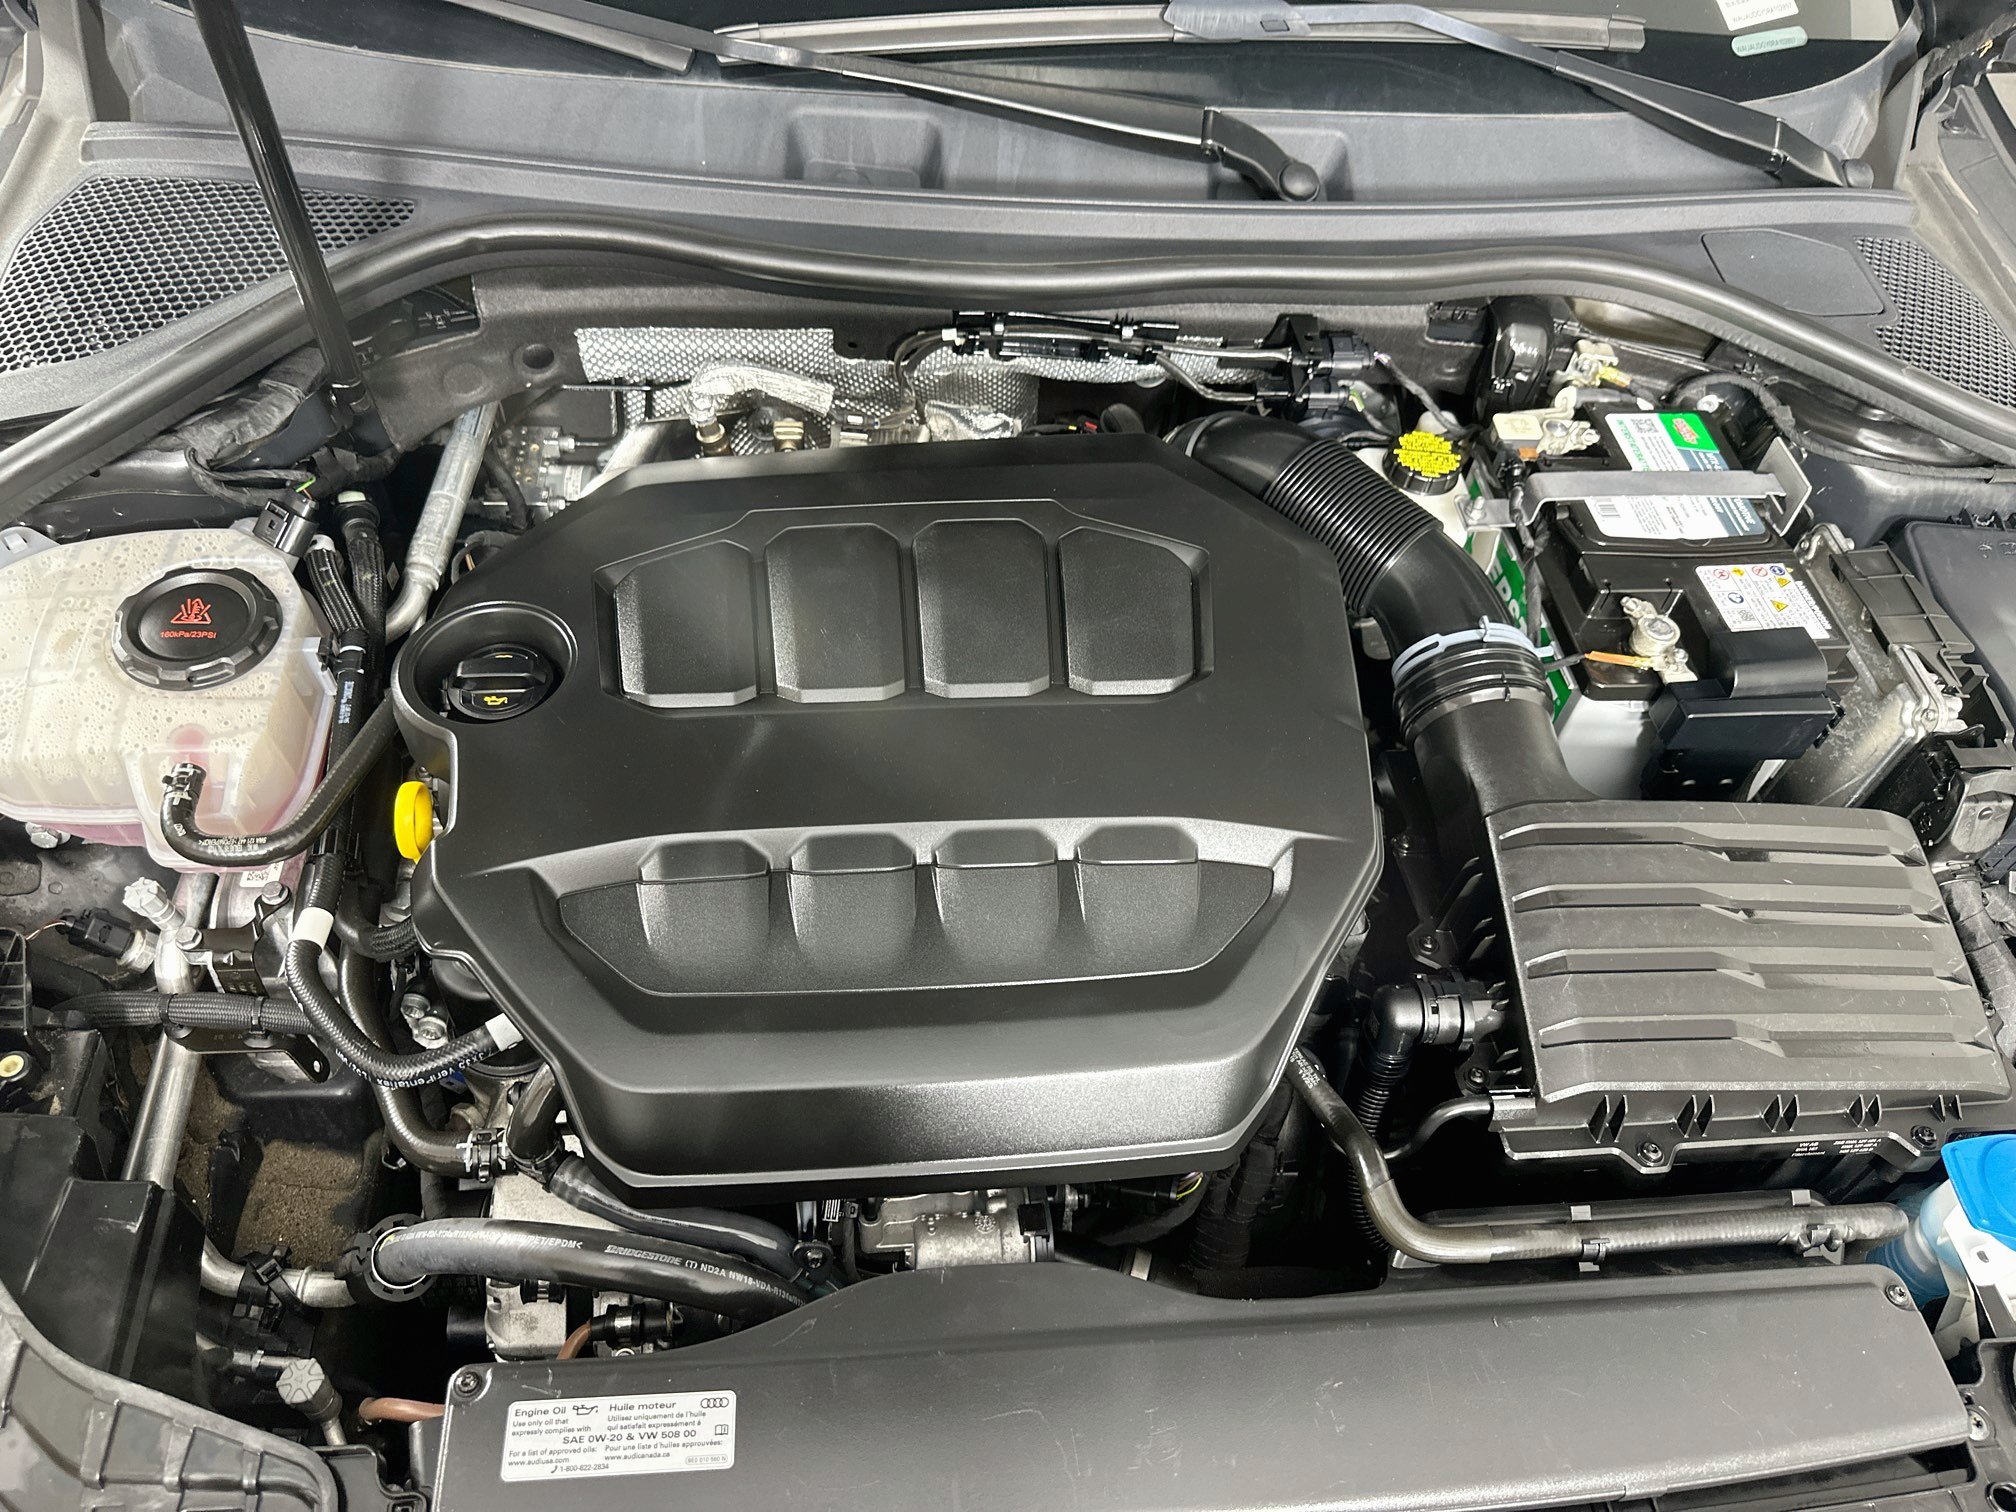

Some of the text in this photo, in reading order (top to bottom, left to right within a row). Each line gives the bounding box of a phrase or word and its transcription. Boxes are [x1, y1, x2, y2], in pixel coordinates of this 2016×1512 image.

[160, 630, 216, 639] 160kPa/23PSI
[605, 1245, 683, 1265] BRIDGESTONE
[685, 1258, 698, 1270] (T)
[700, 1262, 726, 1277] ND2A
[609, 1403, 635, 1411] Huile
[515, 1406, 566, 1417] Engine Oil
[634, 1413, 674, 1421] uniquement
[607, 1423, 618, 1431] qui
[512, 1428, 543, 1436] expressly
[562, 1436, 585, 1444] SAE
[588, 1434, 623, 1443] 0W-20
[548, 1447, 581, 1455] approved
[604, 1452, 670, 1460] www.audicanada.ca
[508, 1457, 570, 1466] www.audiusa.com
